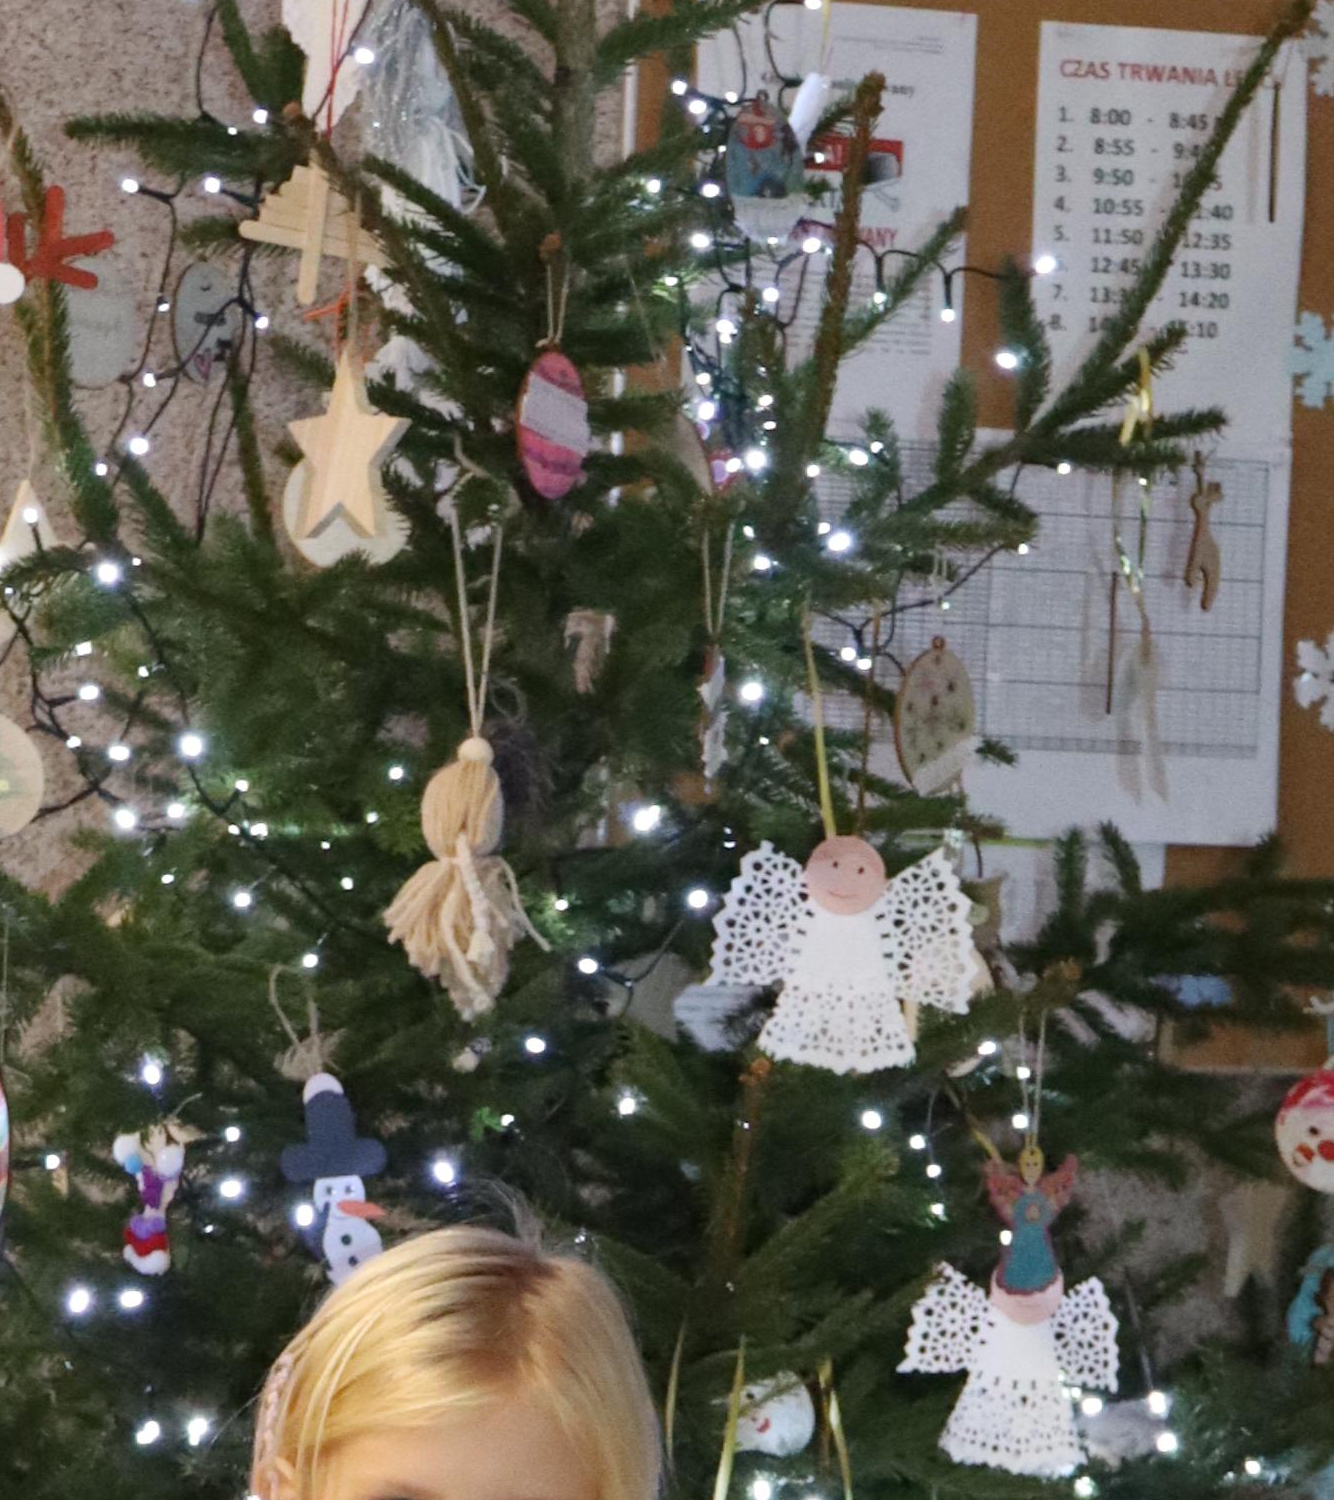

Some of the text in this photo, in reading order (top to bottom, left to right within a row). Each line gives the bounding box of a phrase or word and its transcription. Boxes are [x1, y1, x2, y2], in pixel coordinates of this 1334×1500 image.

[1060, 60, 1110, 79] CZAS
[1118, 63, 1219, 86] TRWANIA
[1090, 108, 1131, 126] 8:00
[1169, 113, 1209, 130] 8:45
[1094, 137, 1135, 156] 8:55
[1093, 167, 1134, 186] 9:50
[1093, 198, 1144, 216] 10:55
[1092, 228, 1143, 246] 11:50
[1181, 262, 1231, 280] 13:30
[1179, 292, 1230, 310] 14:20
